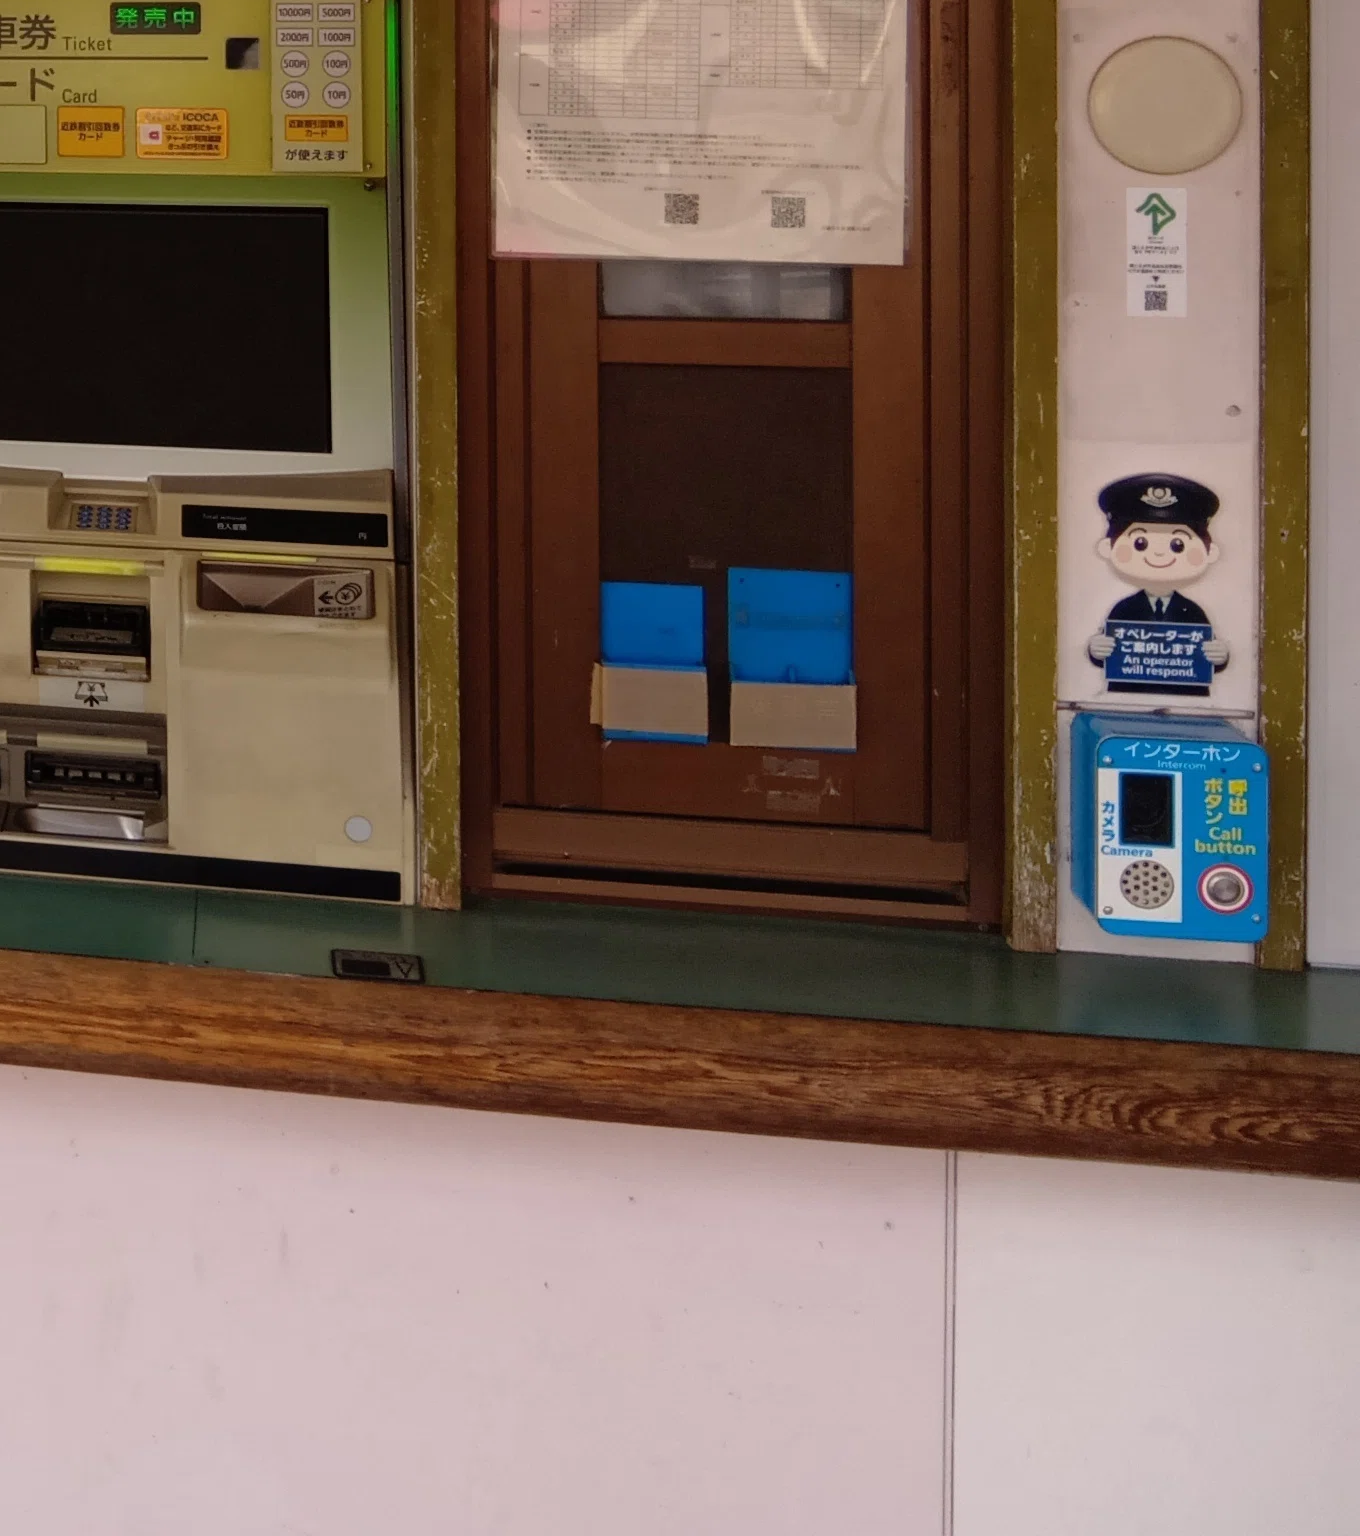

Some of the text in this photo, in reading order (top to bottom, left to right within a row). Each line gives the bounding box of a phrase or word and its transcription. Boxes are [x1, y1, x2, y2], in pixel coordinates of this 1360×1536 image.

[116, 7, 196, 29] 発売中
[322, 9, 351, 17] 5000円
[62, 36, 112, 51] Ticket
[281, 33, 309, 42] 2000円
[323, 33, 351, 42] 1000円
[283, 59, 307, 68] 500円
[326, 60, 348, 68] 100円
[62, 90, 97, 103] Card
[285, 91, 304, 101] 50円
[328, 91, 346, 99] 10円
[183, 113, 219, 122] ICOCA
[78, 133, 104, 141] カード
[285, 149, 348, 161] が使えます
[1114, 628, 1203, 642] オペレーターが
[1121, 641, 1197, 655] ご案内します
[1123, 655, 1194, 667] An operator
[1122, 665, 1197, 678] will respond.
[1124, 741, 1241, 762] インターホン
[1158, 761, 1206, 770] Intercom
[1204, 777, 1223, 825] ボタン
[1228, 779, 1248, 815] 呼出
[1102, 801, 1115, 842] カメラ
[1209, 826, 1242, 841] Call
[1101, 845, 1153, 857] Camera
[1195, 839, 1256, 856] button
